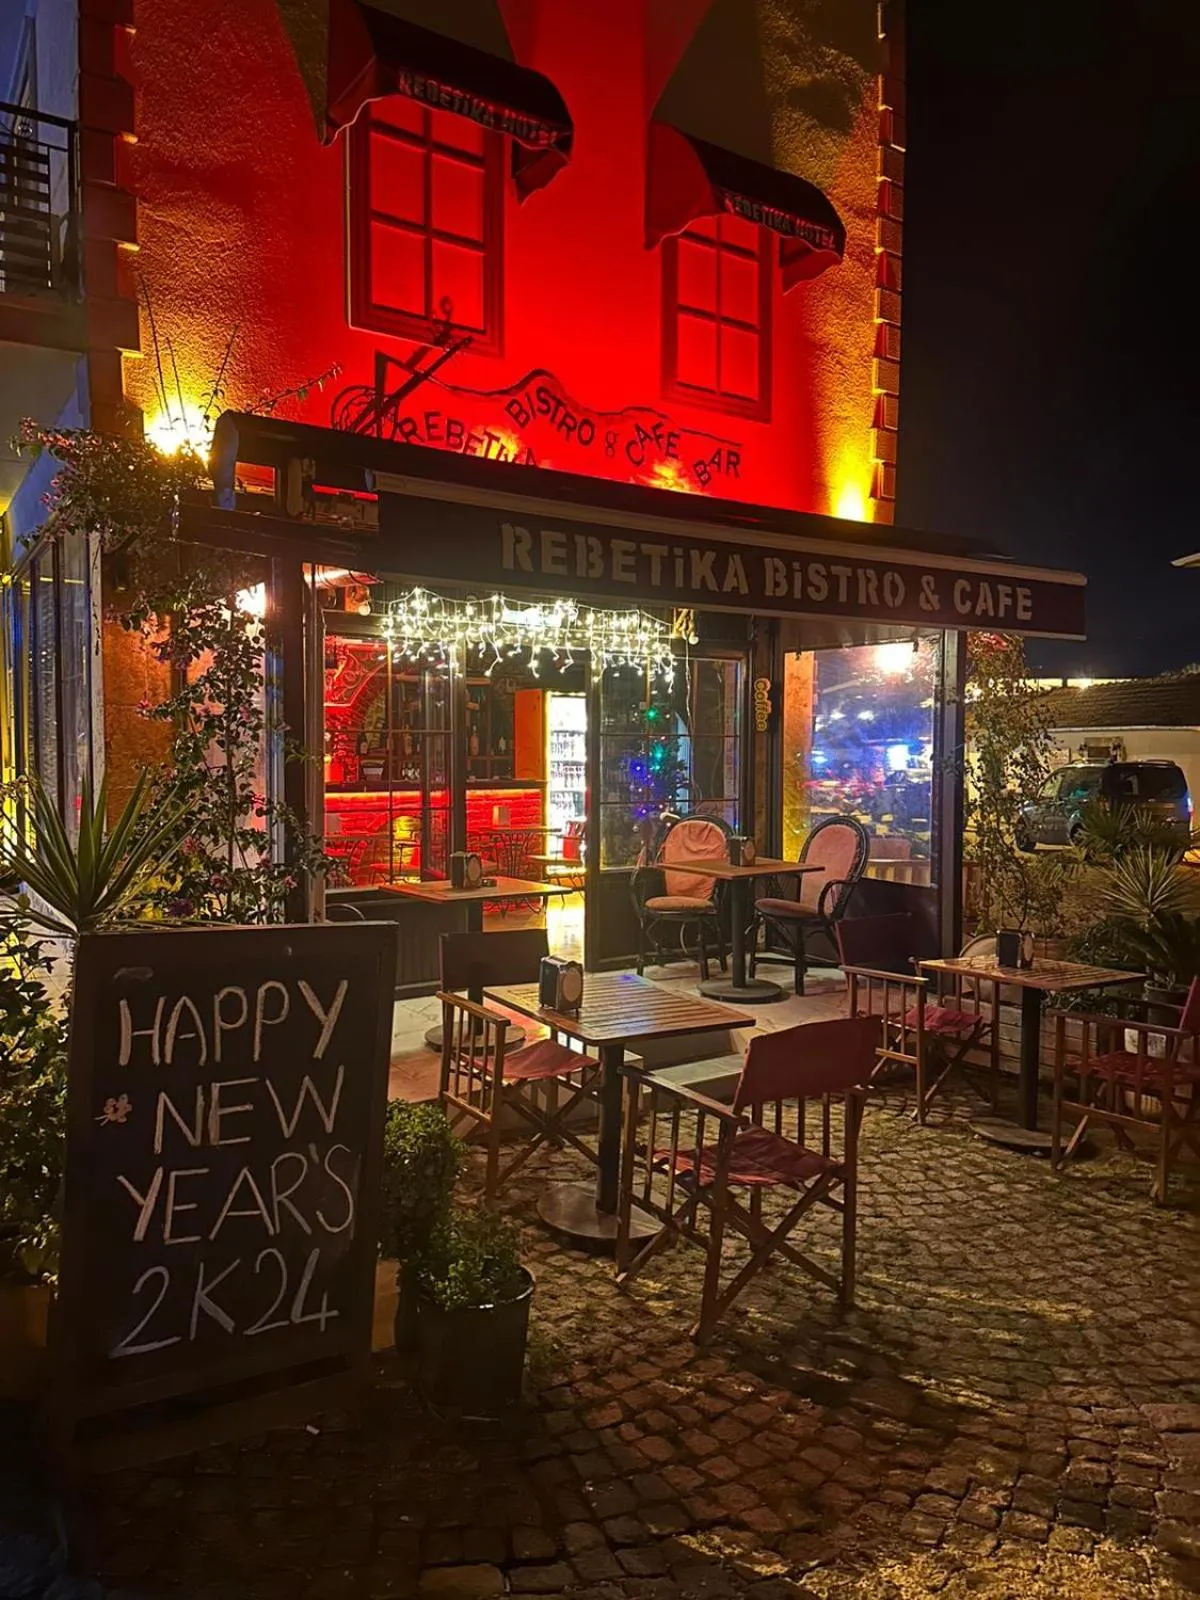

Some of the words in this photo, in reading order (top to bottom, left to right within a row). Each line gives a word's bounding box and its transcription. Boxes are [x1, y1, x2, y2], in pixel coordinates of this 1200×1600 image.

[504, 386, 596, 446] BISTRO
[624, 422, 681, 466] CAFE
[692, 447, 741, 486] BAR
[918, 574, 941, 612] &
[953, 578, 1033, 622] CAFE
[118, 979, 349, 1067] HAPPY
[152, 1064, 345, 1155] NEW
[115, 1142, 355, 1246] YEAR'S
[107, 1247, 340, 1359] 2K24
